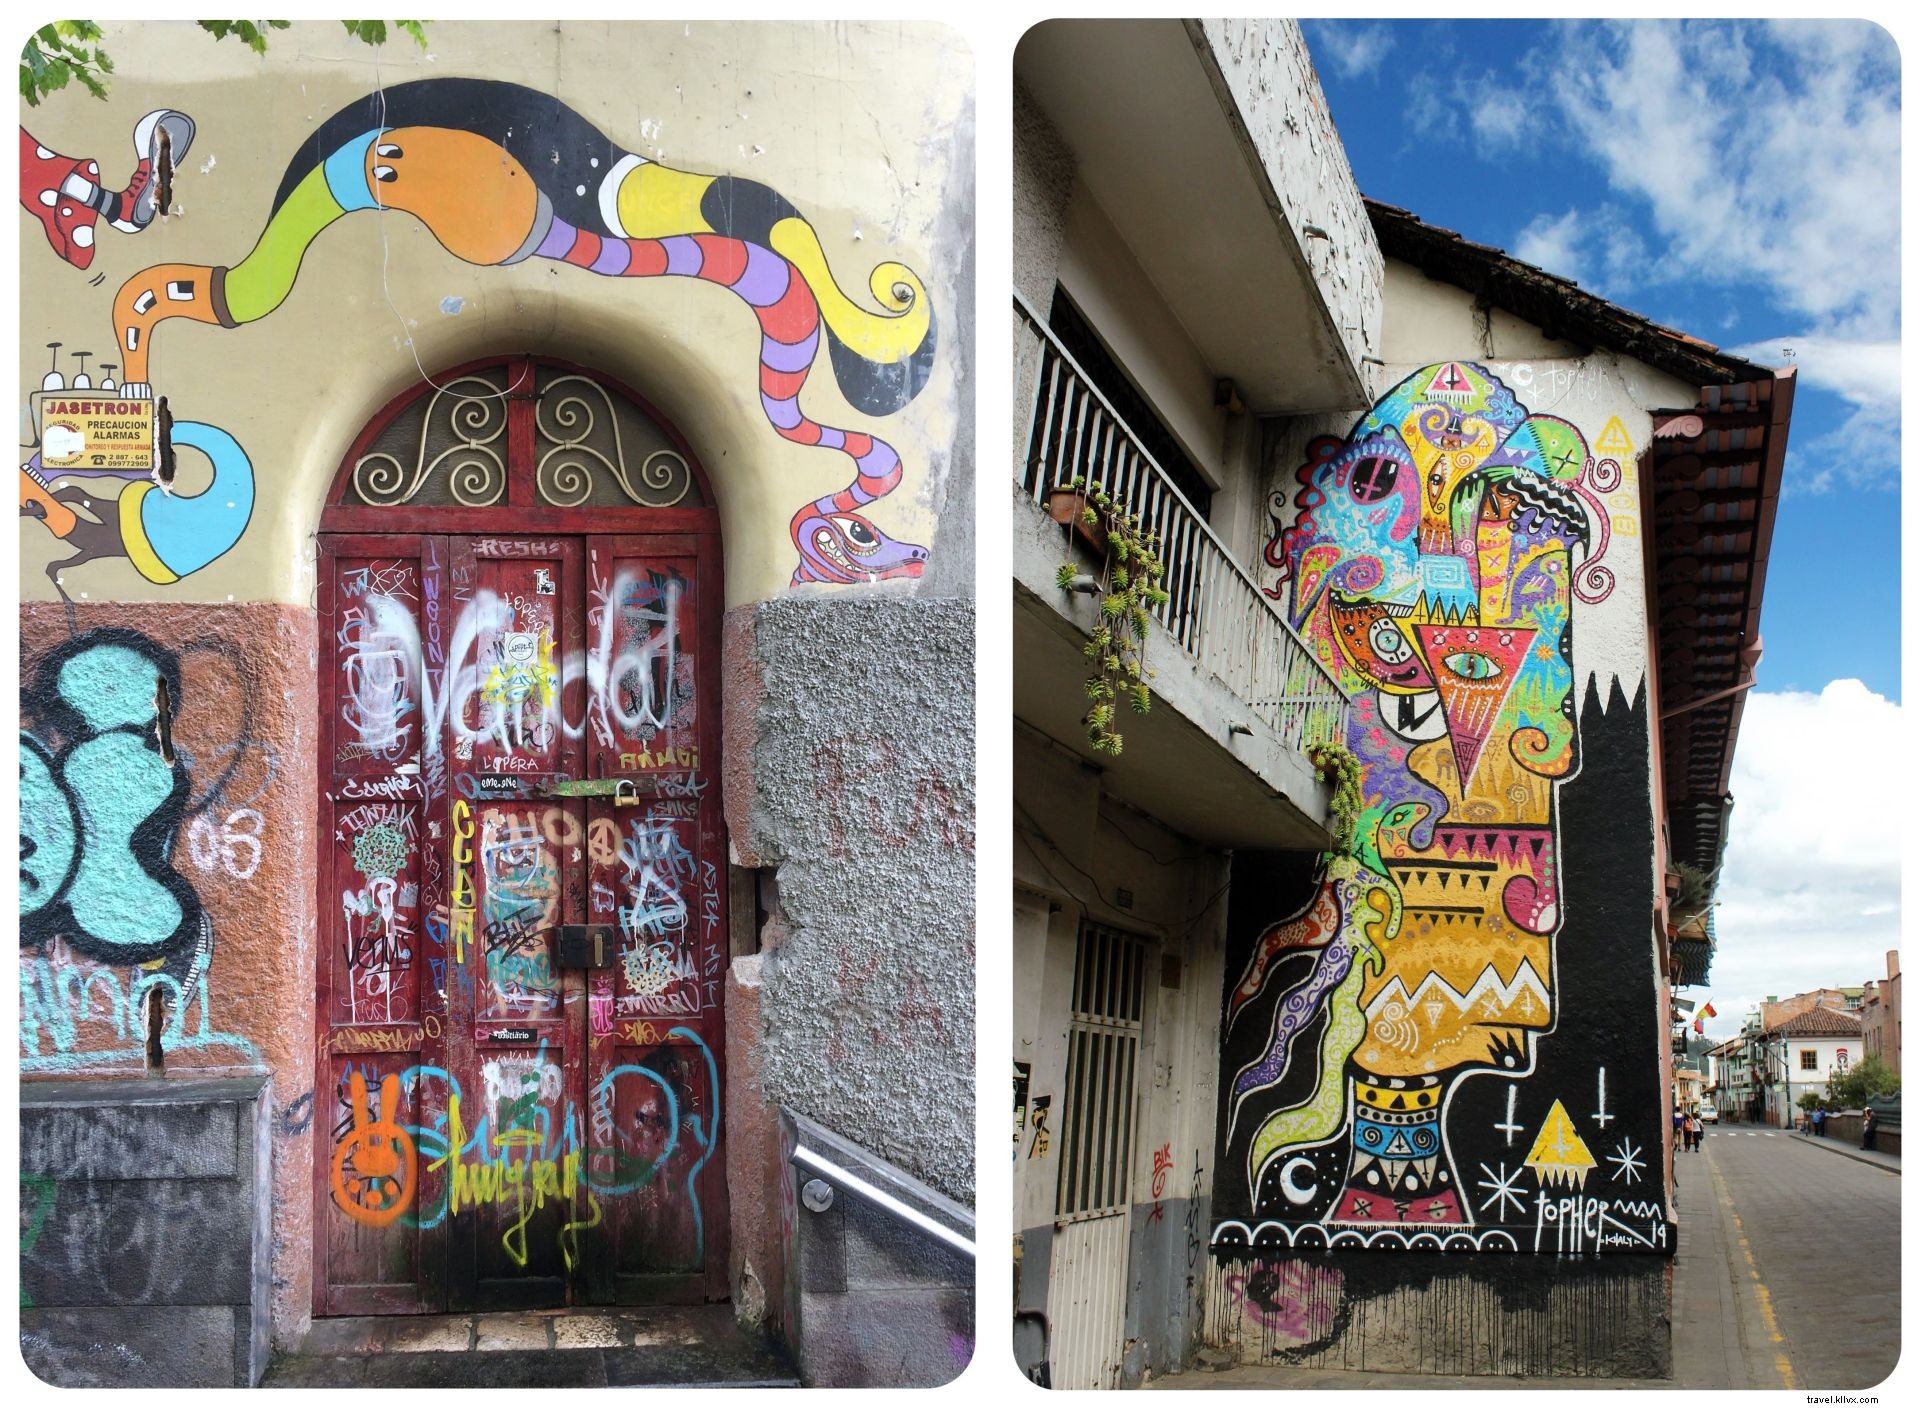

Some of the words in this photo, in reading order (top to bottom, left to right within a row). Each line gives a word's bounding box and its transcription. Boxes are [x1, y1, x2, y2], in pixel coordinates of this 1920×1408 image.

[46, 401, 142, 415] JASETRON
[87, 420, 148, 430] PRECAUCION
[93, 431, 141, 440] ALARMAS
[44, 454, 84, 468] LECTRONICA
